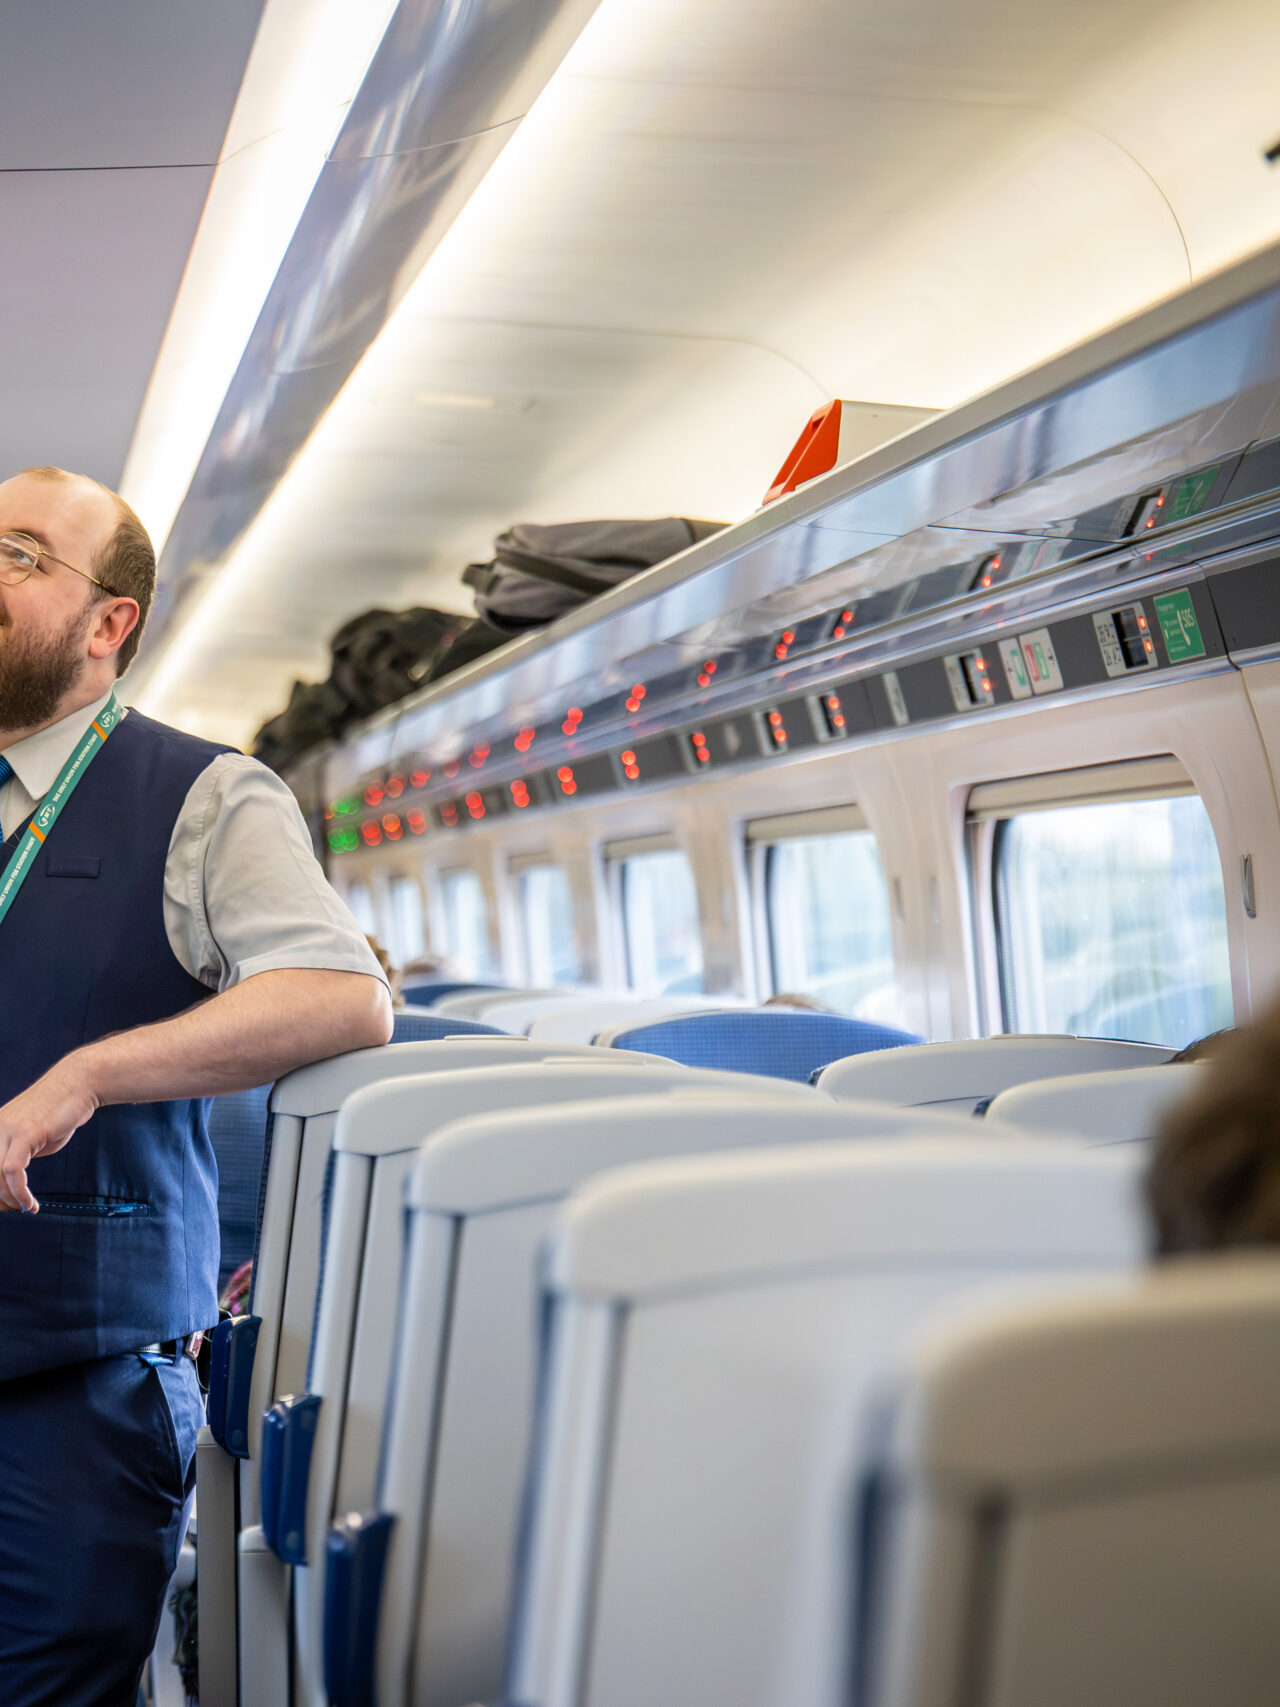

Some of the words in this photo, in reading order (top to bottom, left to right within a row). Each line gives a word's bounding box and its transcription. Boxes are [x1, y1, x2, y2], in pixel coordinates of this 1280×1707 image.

[52, 793, 61, 802] THE
[57, 782, 67, 795] ONLY
[72, 760, 80, 770] FOR
[4, 878, 15, 895] UNION
[11, 869, 19, 879] FOR
